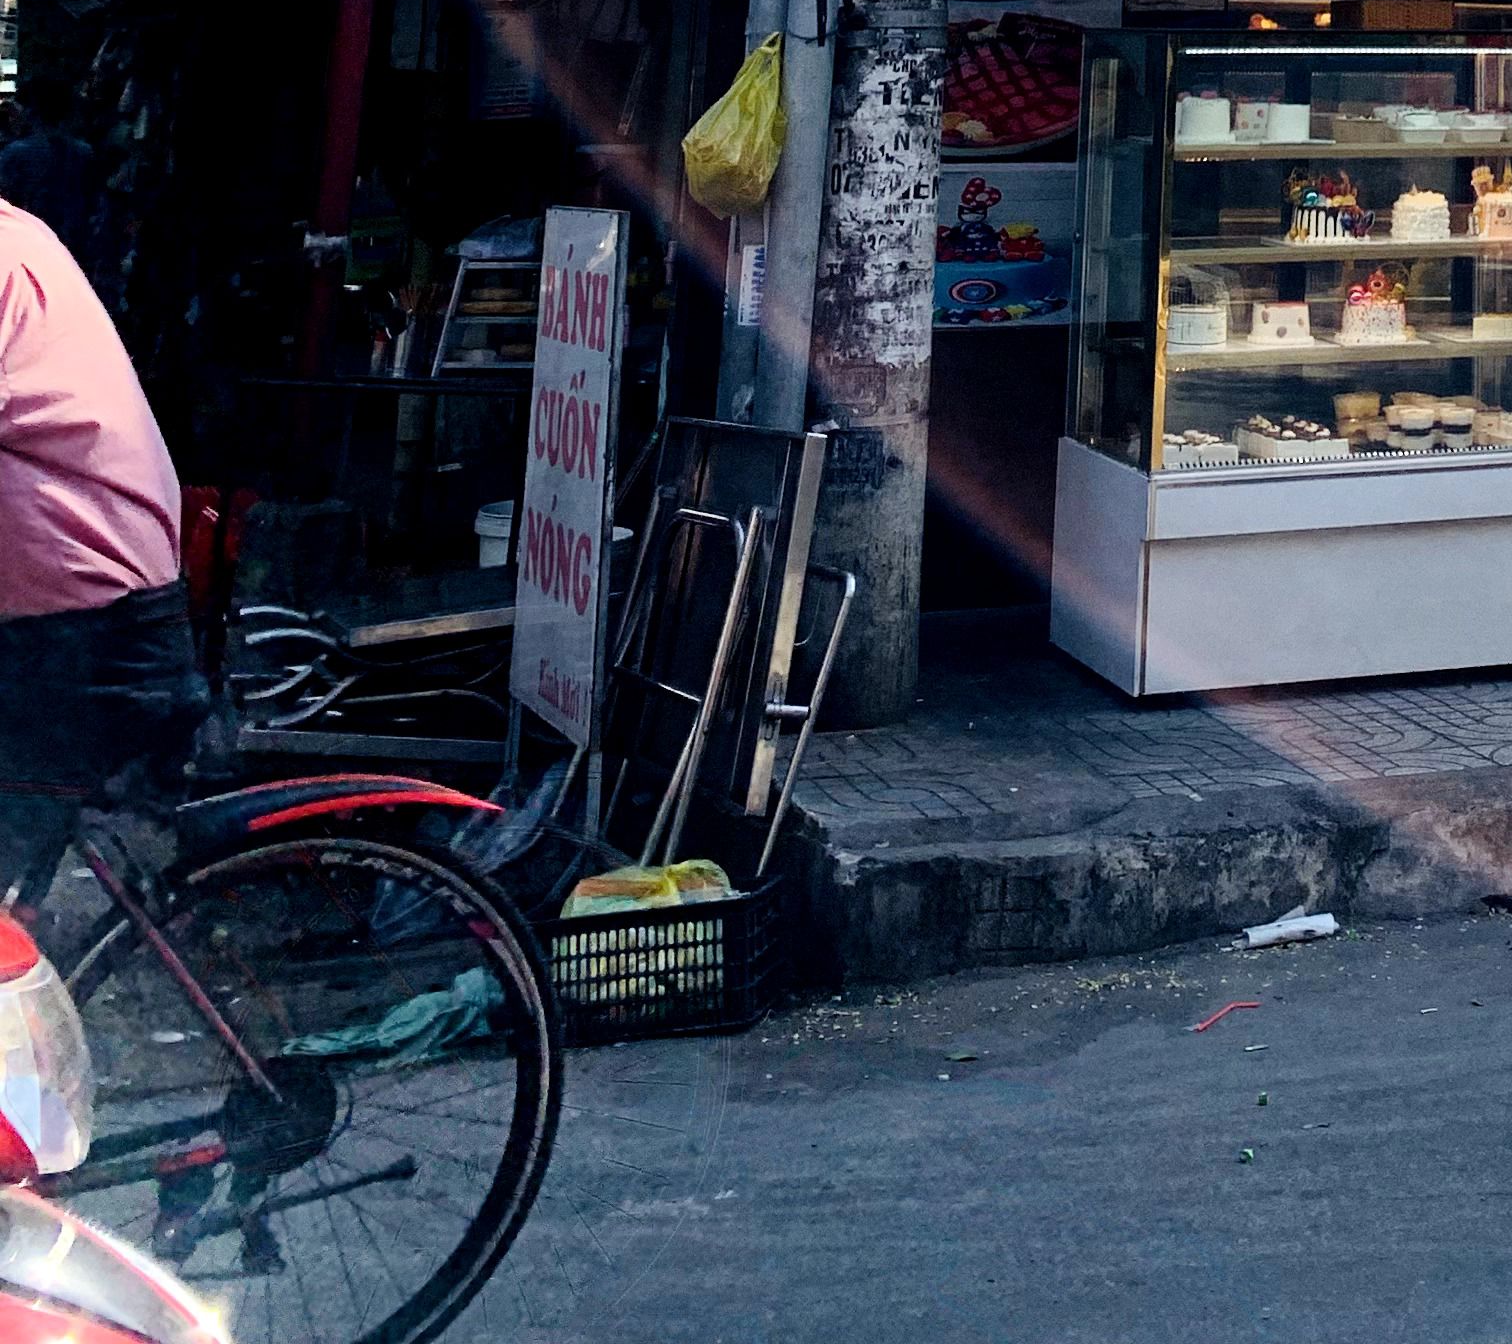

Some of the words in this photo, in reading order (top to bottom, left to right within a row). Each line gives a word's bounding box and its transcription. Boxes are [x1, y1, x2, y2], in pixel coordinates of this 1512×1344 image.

[541, 243, 610, 353] BÁNH
[534, 368, 602, 483] CUỐN
[523, 493, 593, 616] NÓNG
